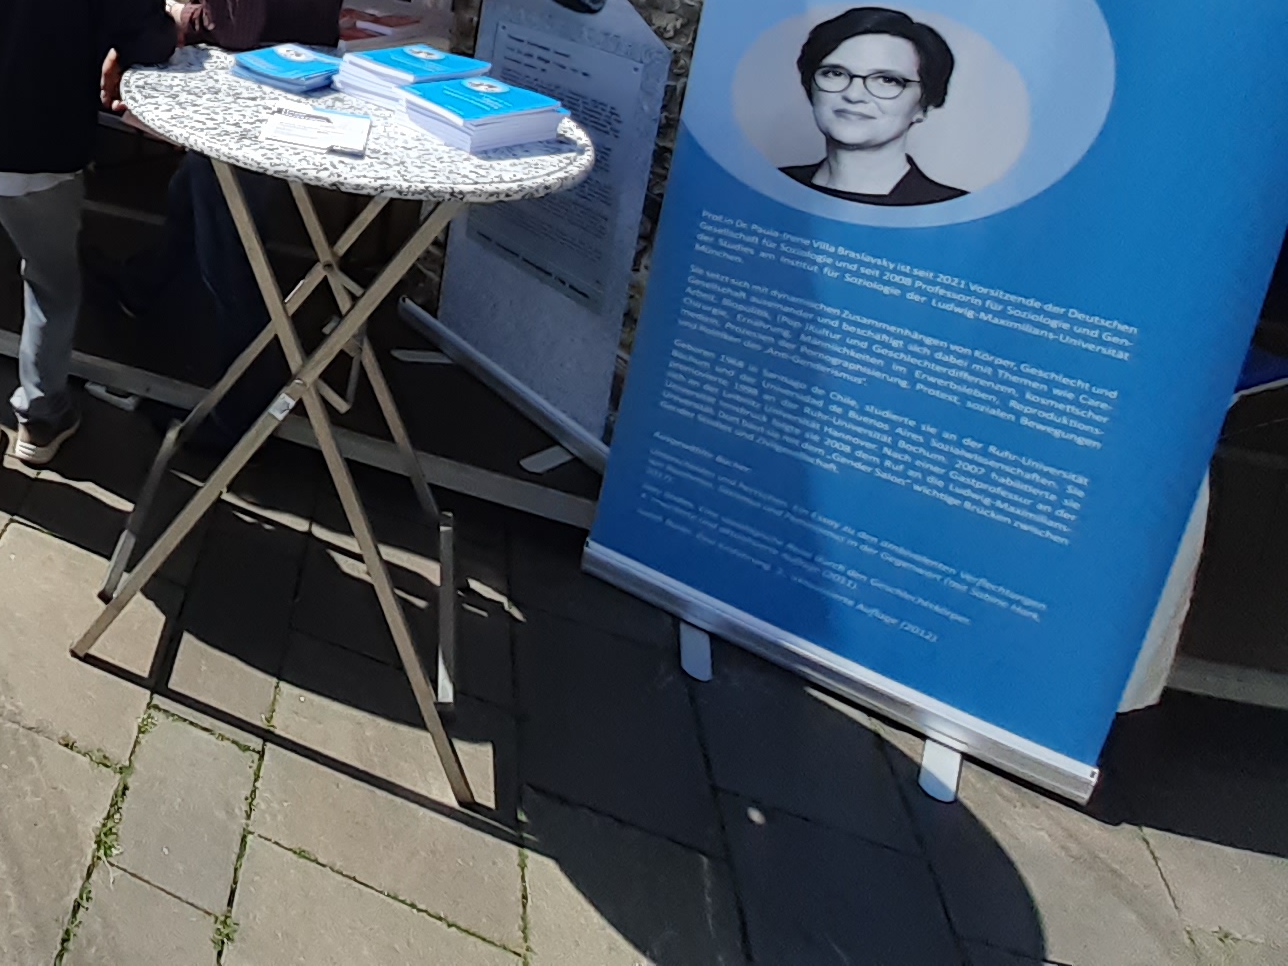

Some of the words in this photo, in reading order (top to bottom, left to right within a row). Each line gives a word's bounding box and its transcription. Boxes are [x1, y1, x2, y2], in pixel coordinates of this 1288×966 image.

[811, 239, 835, 252] Villa
[836, 246, 897, 270] Braslavsky
[896, 262, 911, 273] ist
[911, 267, 934, 279] seit
[936, 273, 966, 288] 2021
[967, 281, 1042, 309] Vorsitzende
[1067, 308, 1139, 335] Deutschen
[822, 266, 840, 278] für
[842, 272, 902, 298] Soziologie
[904, 290, 928, 304] der
[834, 258, 858, 271] und
[881, 271, 913, 286] 2008
[913, 280, 983, 306] Professorin
[1004, 305, 1072, 332] Soziologie
[1072, 323, 1100, 338] und
[840, 309, 949, 350] Zusammenhängen
[948, 343, 973, 356] von
[1018, 362, 1090, 391] Geschlecht
[1090, 384, 1118, 399] und
[845, 335, 868, 349] und
[996, 369, 1049, 392] Themen
[1018, 416, 1102, 451] Bewegungen
[960, 435, 984, 450] der
[986, 443, 1090, 486] Ruhr-Universität
